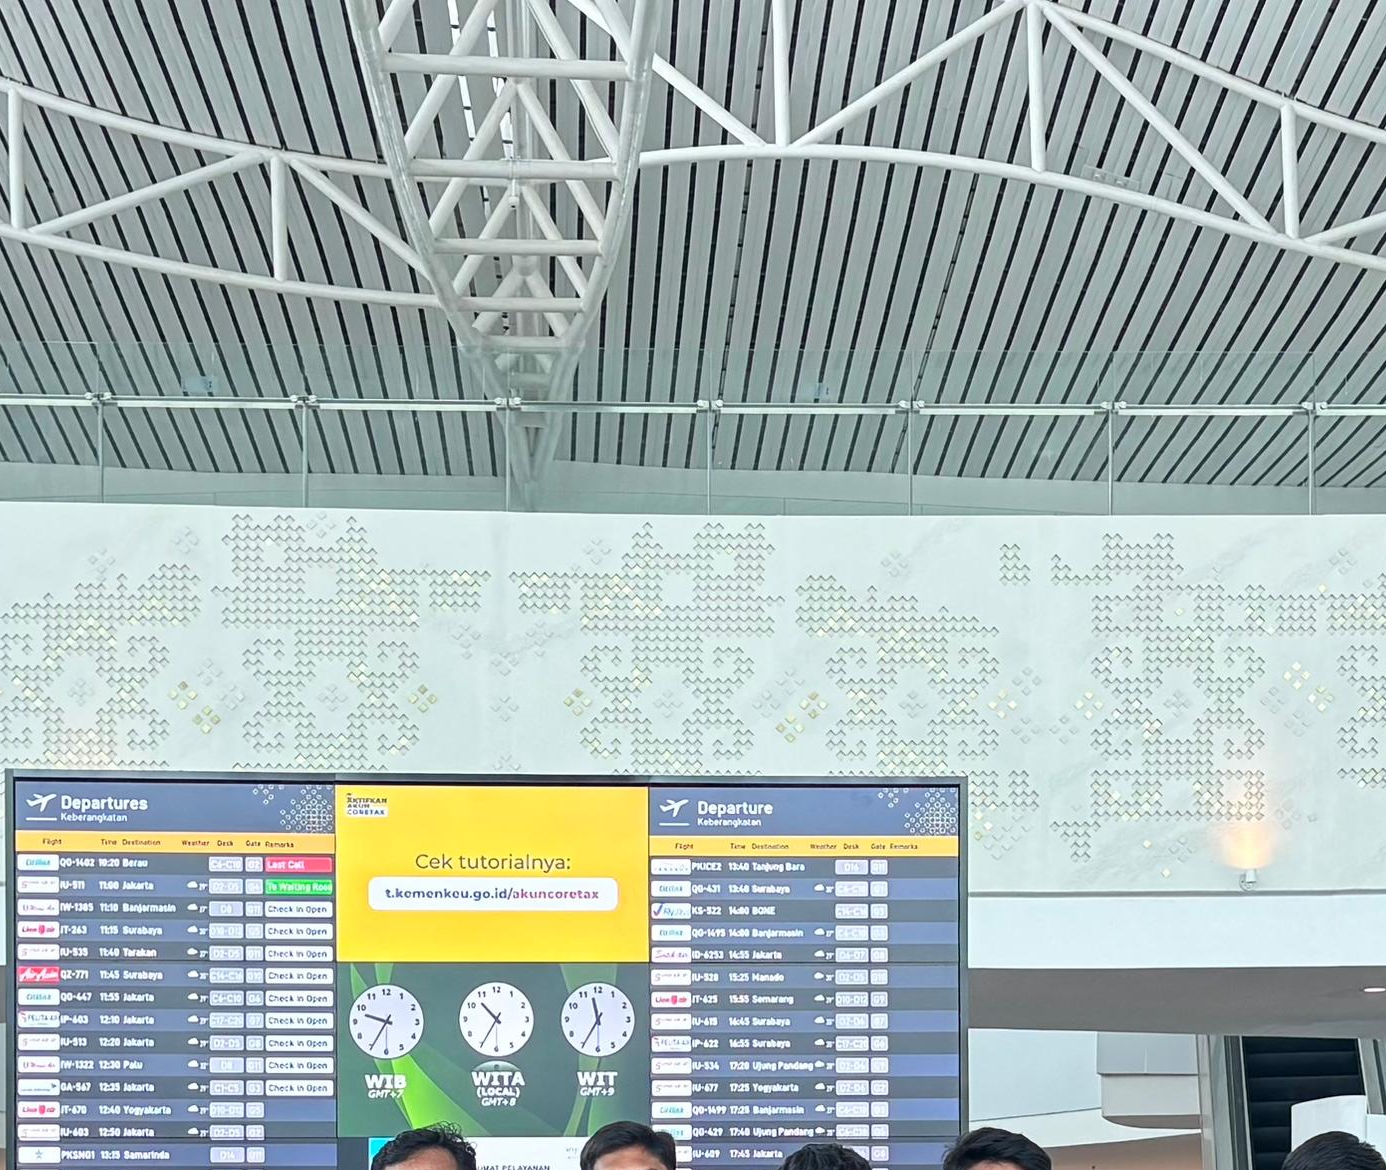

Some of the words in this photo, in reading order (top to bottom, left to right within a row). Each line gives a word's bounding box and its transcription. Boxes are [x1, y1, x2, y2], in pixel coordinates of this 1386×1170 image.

[60, 795, 149, 813] Departures
[697, 800, 773, 817] Departure
[60, 812, 128, 823] Keberangkatan
[697, 818, 762, 828] Keberangkatan
[415, 853, 453, 869] Cek
[459, 854, 571, 874] tutorialnya:
[268, 904, 294, 913] Check
[268, 925, 294, 935] Check
[268, 948, 294, 957] Check
[364, 1074, 407, 1089] WIB
[471, 1071, 526, 1087] WITA
[576, 1071, 618, 1086] WIT
[368, 1088, 405, 1098] GMT+7
[476, 1086, 521, 1098] (LOCAL)
[580, 1086, 615, 1097] GMT+9
[481, 1096, 517, 1107] GMT+8
